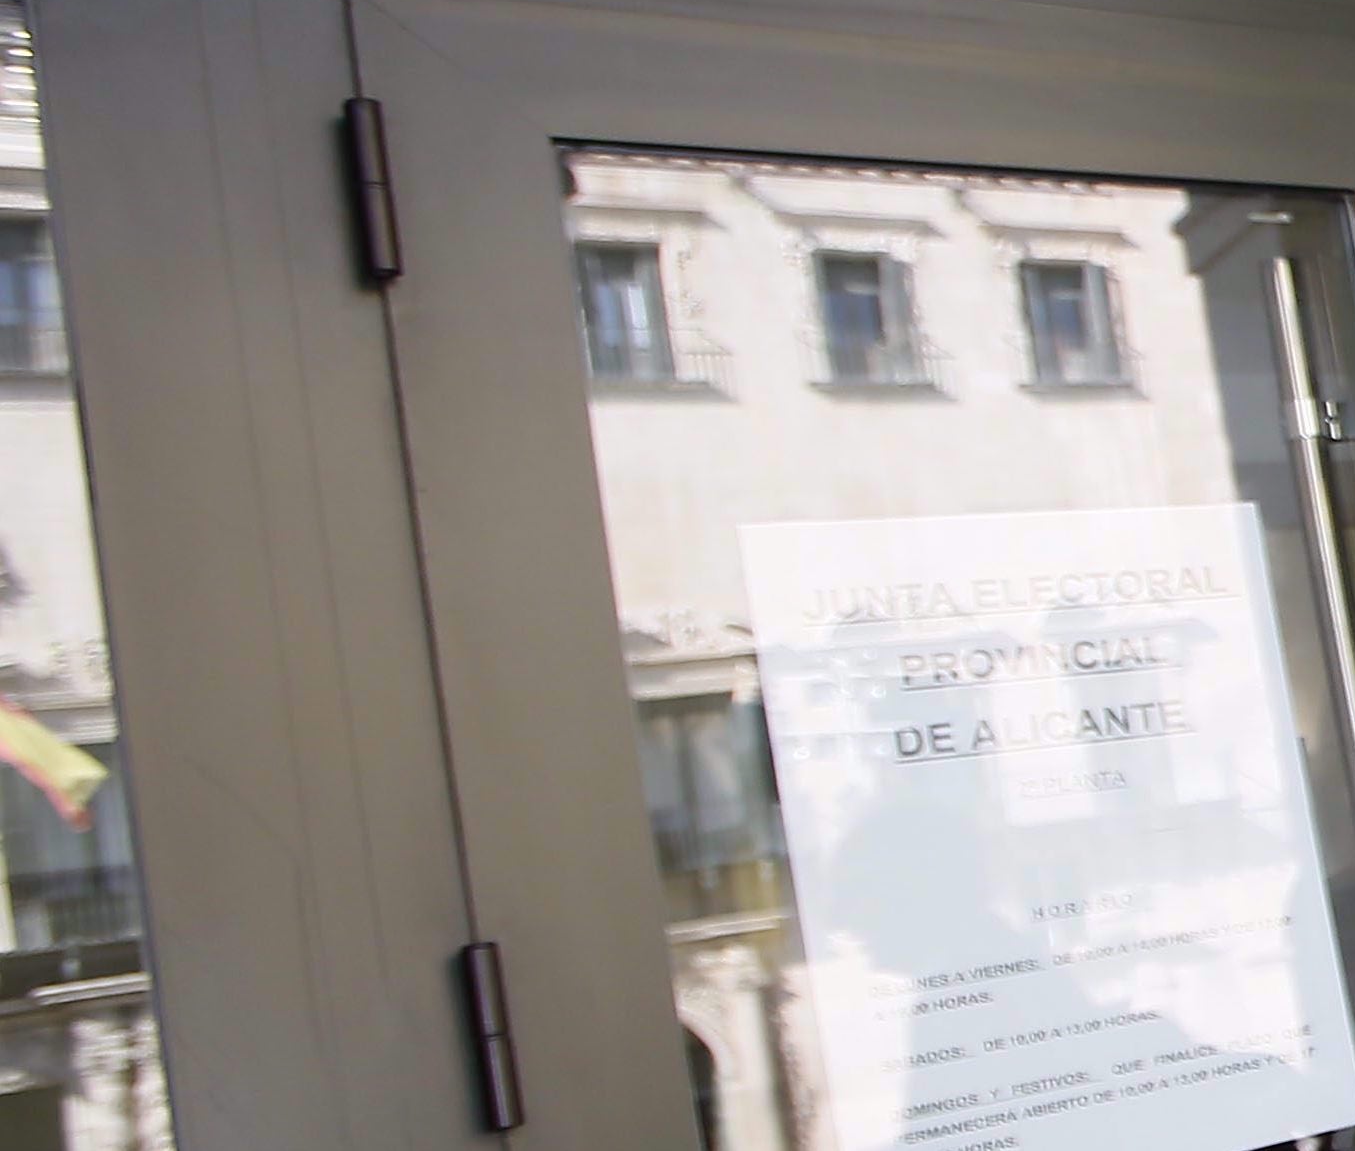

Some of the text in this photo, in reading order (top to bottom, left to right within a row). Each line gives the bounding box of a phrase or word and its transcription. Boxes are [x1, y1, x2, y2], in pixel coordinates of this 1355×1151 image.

[802, 565, 1229, 622] JUNTA ELECTORAL
[899, 636, 1169, 685] PROVINCIAL
[895, 700, 1188, 757] DE ALICANTE
[901, 974, 949, 993] UNES
[881, 1047, 967, 1072] BADOS:
[983, 1038, 1006, 1052] DE
[1050, 1027, 1062, 1039] A
[989, 1088, 1000, 1099] Y
[1112, 1059, 1145, 1076] QUE
[1154, 1045, 1218, 1065] FINALICE
[1023, 1095, 1088, 1119] ABIERTO
[1093, 1090, 1116, 1104] DE
[1159, 1077, 1169, 1089] A
[1212, 1059, 1261, 1077] HORAS
